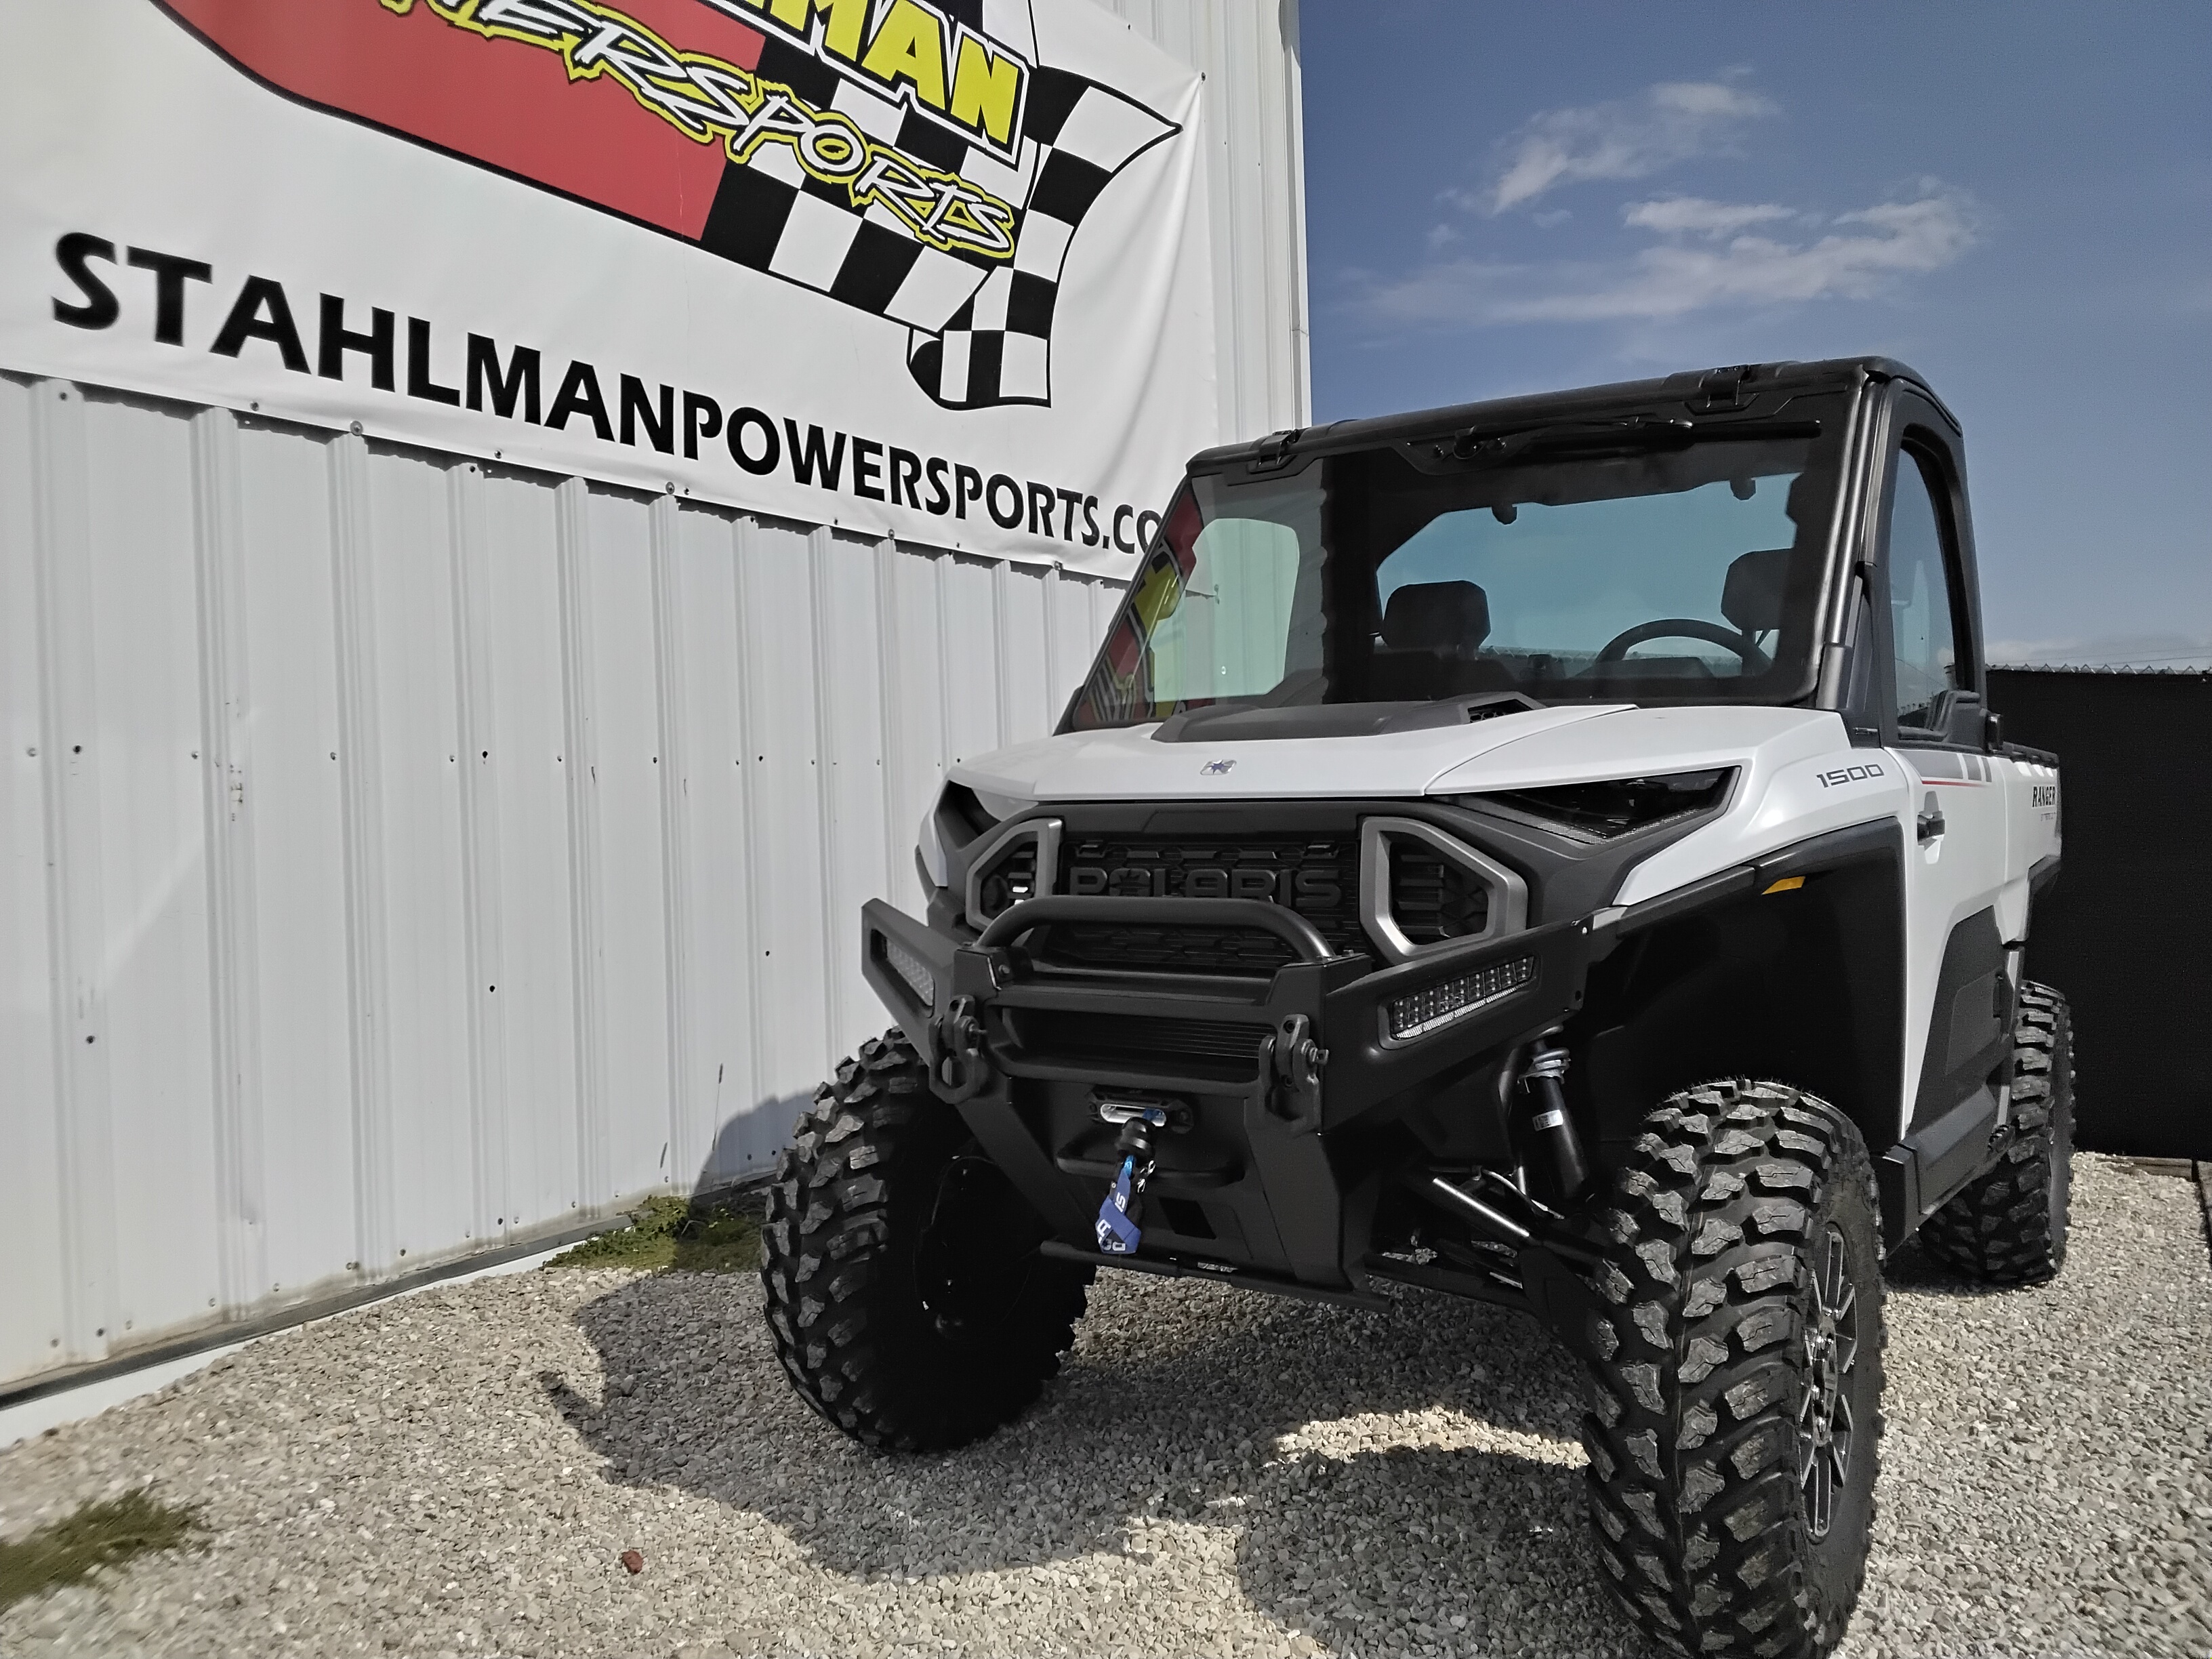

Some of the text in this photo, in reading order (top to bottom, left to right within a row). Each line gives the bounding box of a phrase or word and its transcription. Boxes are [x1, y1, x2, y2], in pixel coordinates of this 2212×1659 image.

[1816, 764, 1885, 788] 1500
[2032, 786, 2056, 808] RANGER
[1069, 867, 1343, 908] POLARIS
